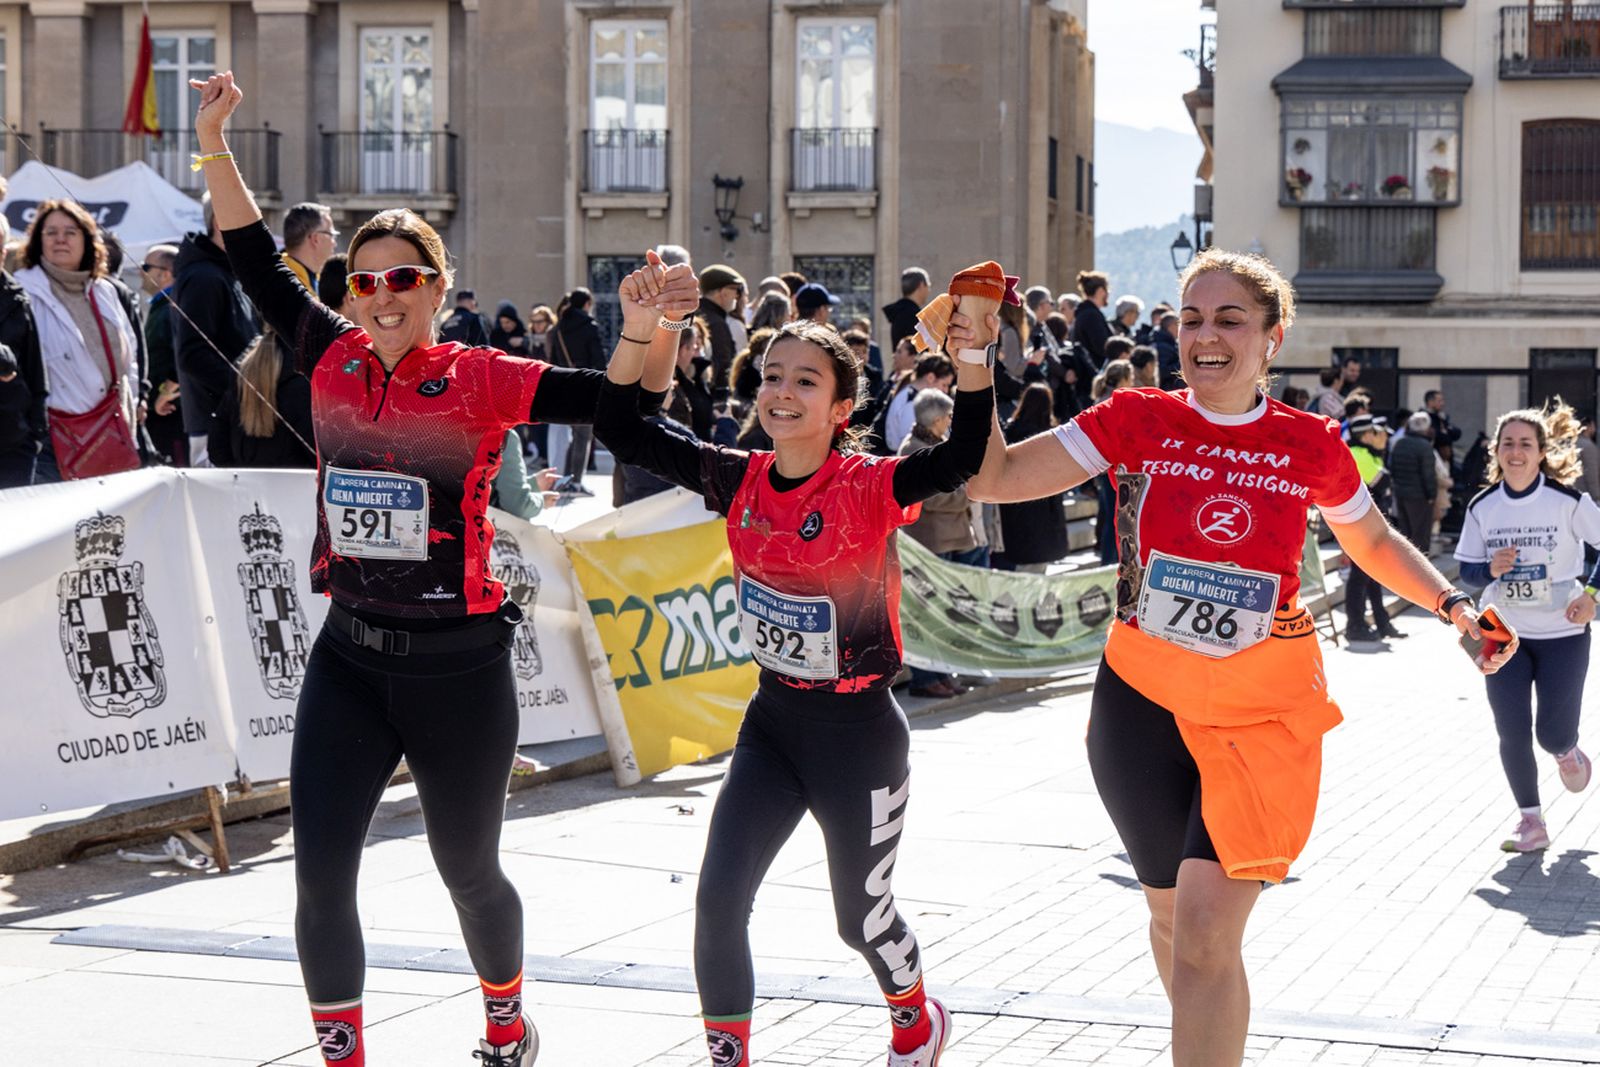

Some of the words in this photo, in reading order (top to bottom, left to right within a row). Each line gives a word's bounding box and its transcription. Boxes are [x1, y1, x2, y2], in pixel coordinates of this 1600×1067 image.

[1161, 437, 1185, 450] IX
[1195, 444, 1291, 469] CARRERA
[370, 481, 412, 491] CAMINATA
[1141, 460, 1215, 481] TESORO
[1226, 471, 1310, 500] VISIGODO
[331, 488, 354, 503] BUENA
[356, 491, 393, 506] MUERTE
[1217, 493, 1252, 511] ZANCADA
[341, 508, 392, 540] 591
[1486, 538, 1509, 548] BUENA
[1511, 536, 1542, 547] MUERTE
[1162, 576, 1195, 593] BUENA
[1198, 582, 1239, 604] MUERTE
[1175, 567, 1216, 581] CARRERA
[1217, 575, 1261, 590] CAMINATA
[1506, 581, 1533, 598] 513
[746, 597, 768, 618] BUENA
[778, 601, 818, 614] CAMINATA
[1167, 595, 1238, 640] 786
[756, 619, 806, 661] 592
[528, 690, 542, 707] DE
[249, 714, 296, 738] CIUDAD
[57, 734, 130, 763] CIUDAD
[133, 728, 160, 751] DE
[163, 716, 207, 746] JAÉN
